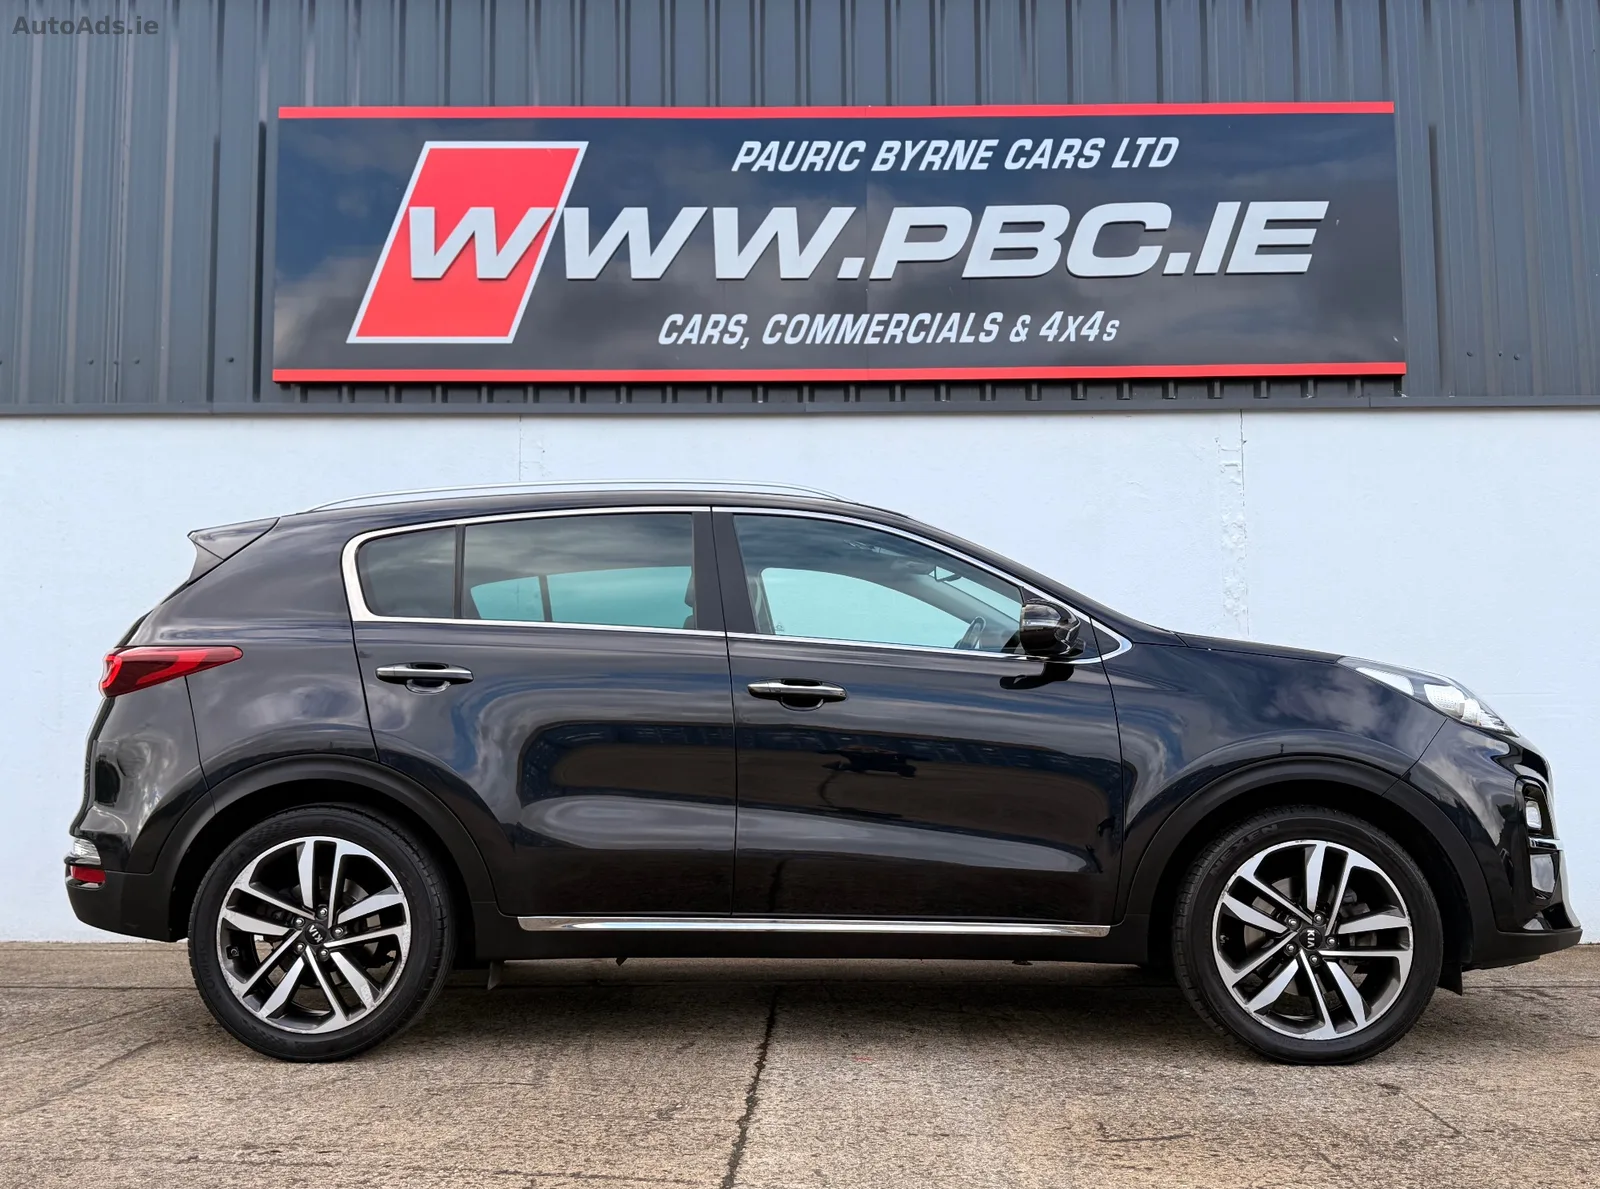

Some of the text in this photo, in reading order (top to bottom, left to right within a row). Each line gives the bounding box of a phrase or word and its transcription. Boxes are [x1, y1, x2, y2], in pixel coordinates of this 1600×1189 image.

[731, 136, 1180, 172] PAURIC BYRNE CARS LTD
[408, 201, 1330, 280] WWW.PBC.IE
[658, 313, 749, 349] CARS,
[761, 312, 1003, 346] COMMERCIALS
[1009, 314, 1032, 343] &
[1210, 823, 1279, 877] NEXEN
[309, 924, 323, 943] KIA
[1307, 929, 1316, 948] KIA
